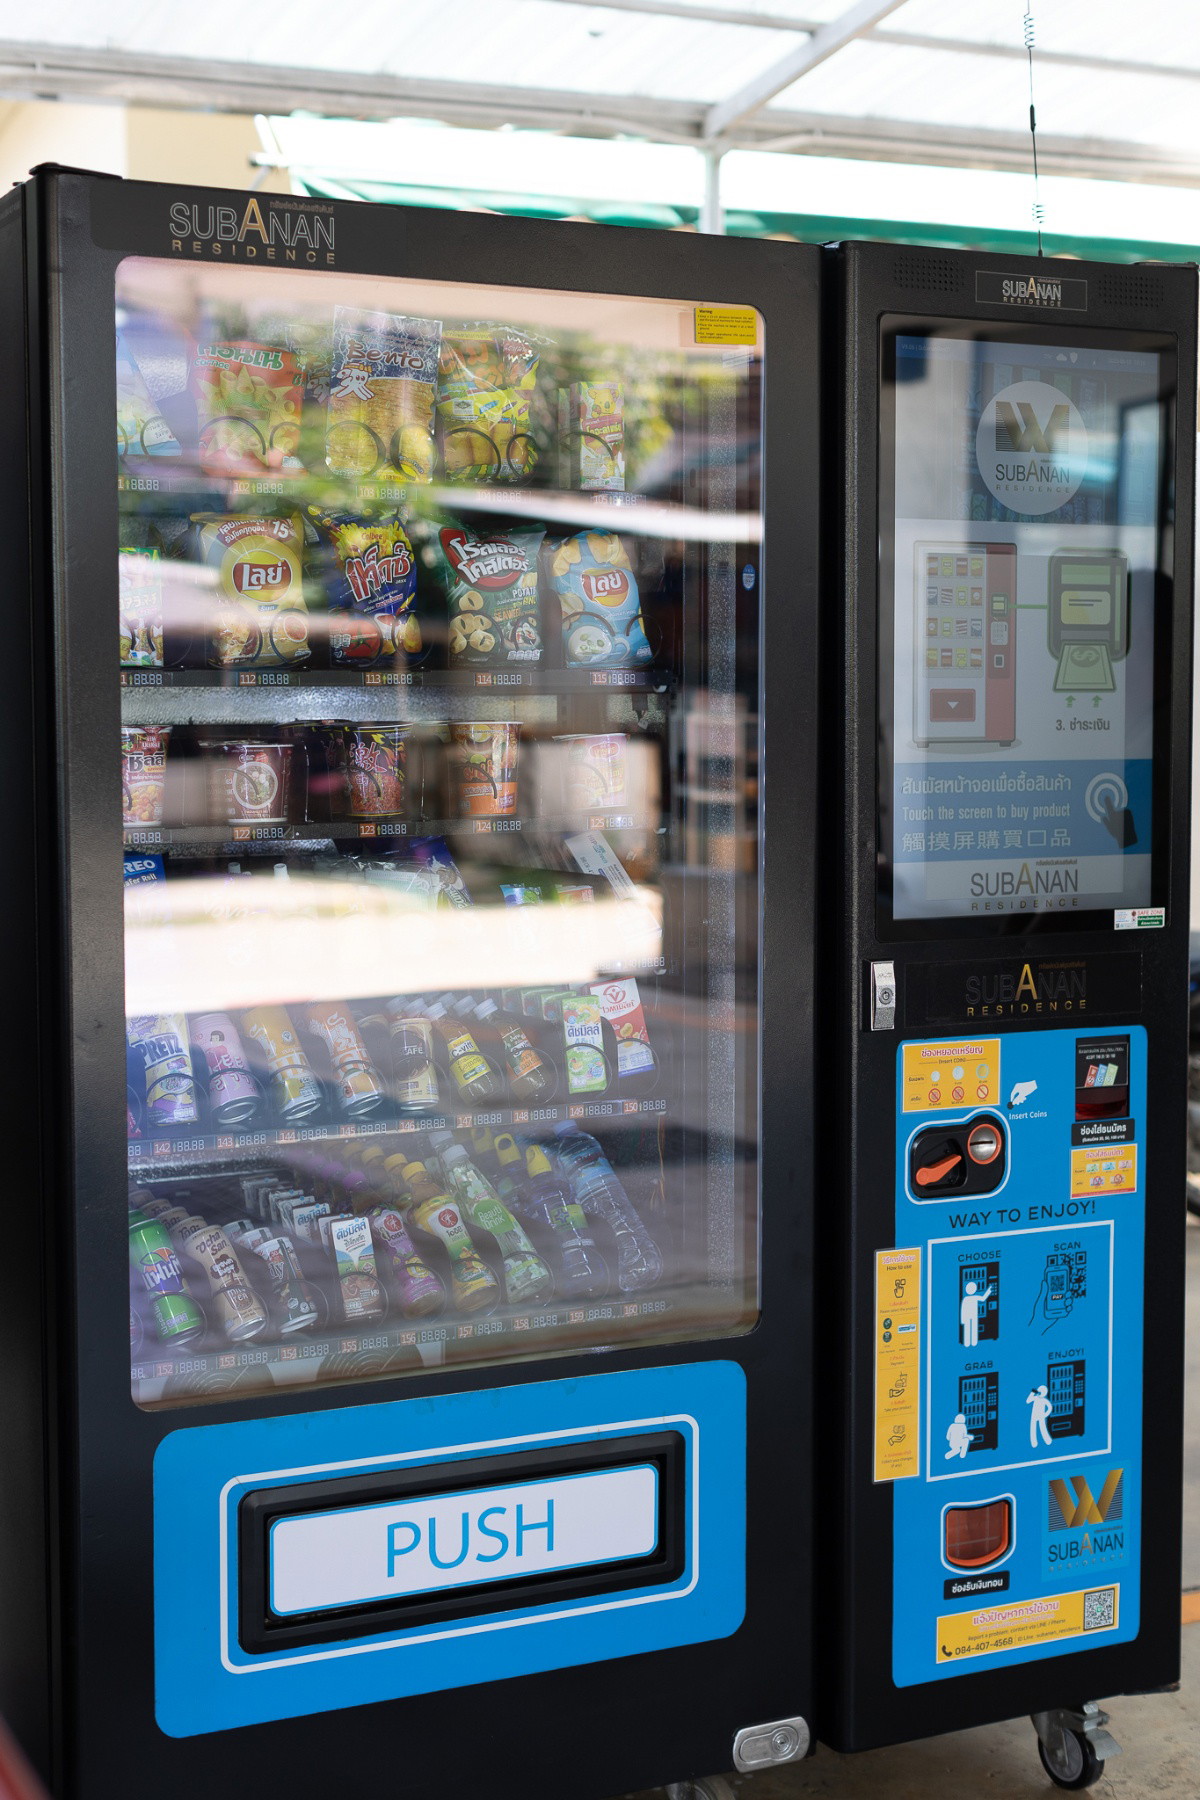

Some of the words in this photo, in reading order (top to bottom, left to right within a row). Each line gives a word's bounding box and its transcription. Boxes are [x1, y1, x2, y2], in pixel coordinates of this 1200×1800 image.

[169, 198, 334, 250] SUBANAN
[172, 239, 336, 264] RESIDENCE
[1002, 276, 1062, 300] SUBANAN
[1003, 296, 1061, 307] RESIDENCE
[347, 339, 424, 370] Bento
[996, 459, 1070, 484] SUBANAN
[272, 520, 289, 538] 15
[133, 674, 162, 684] 88.88
[240, 674, 256, 684] 112
[262, 674, 290, 684] 88.88
[366, 674, 381, 684] 113
[386, 674, 412, 684] 88.88
[478, 674, 492, 684] 114
[497, 674, 522, 684] 88.88
[592, 674, 607, 684] 115
[612, 674, 636, 684] 88.88
[1056, 720, 1066, 731] 3.
[1070, 717, 1110, 731] ชำระเงิน
[902, 770, 1072, 794] สัมผัสหน้าจอเพื่อซื้อสินค้า
[902, 804, 934, 821] Touch
[938, 804, 954, 820] the
[958, 806, 993, 820] screen
[997, 804, 1008, 818] to
[1011, 804, 1028, 821] buy
[1033, 802, 1070, 820] product
[360, 825, 375, 836] 123
[381, 824, 407, 835] 88.88
[476, 821, 492, 832] 124
[496, 820, 522, 832] 88.88
[132, 832, 161, 844] 88.88
[234, 829, 250, 840] 122
[256, 828, 284, 839] 88.88
[970, 862, 1078, 897] SUBANAN
[971, 898, 1078, 912] RESIDENCE
[966, 964, 1087, 1004] SUBANAN
[967, 1000, 1086, 1016] RESIDENCE
[134, 1034, 184, 1064] PRETZ
[921, 1045, 984, 1058] ช่องหยอดเหรียญ
[570, 1107, 584, 1116] 149
[588, 1104, 612, 1116] 88.88
[624, 1102, 638, 1111] 150
[642, 1100, 666, 1111] 88.88
[457, 1116, 472, 1126] 147
[476, 1114, 502, 1124] 88.88
[514, 1112, 528, 1121] 148
[533, 1109, 558, 1120] 88.88
[1008, 1112, 1028, 1120] Insert
[1030, 1110, 1048, 1119] Coins
[340, 1126, 356, 1136] 145
[362, 1124, 387, 1135] 88.88
[400, 1121, 415, 1130] 146
[420, 1118, 446, 1130] 88.88
[217, 1138, 233, 1148] 143
[239, 1134, 267, 1146] 88.88
[280, 1131, 296, 1141] 144
[302, 1128, 328, 1140] 88.88
[154, 1142, 171, 1154] 142
[176, 1140, 204, 1152] 88.88
[949, 1211, 992, 1229] WAY
[996, 1208, 1022, 1223] TO
[1028, 1202, 1096, 1222] ENJOY!
[484, 1216, 506, 1230] Drink
[210, 1240, 227, 1256] San
[1054, 1241, 1082, 1252] SCAN
[957, 1250, 1002, 1262] CHOOSE
[624, 1305, 638, 1314] 160
[642, 1302, 666, 1313] 88.88
[570, 1312, 584, 1322] 159
[588, 1309, 612, 1320] 88.88
[458, 1327, 473, 1336] 157
[477, 1322, 503, 1334] 88.88
[514, 1320, 530, 1329] 158
[532, 1316, 558, 1327] 88.88
[401, 1334, 416, 1344] 156
[421, 1330, 448, 1342] 88.88
[342, 1340, 357, 1351] 155
[362, 1338, 388, 1350] 88.88
[302, 1346, 329, 1358] 88.88
[1048, 1348, 1085, 1360] ENJOY!
[220, 1356, 235, 1366] 153
[242, 1352, 268, 1364] 88.88
[964, 1360, 994, 1371] GRAB
[158, 1364, 174, 1374] 152
[178, 1361, 208, 1372] 88.88
[388, 1498, 554, 1578] PUSH
[1048, 1532, 1124, 1562] SUBANAN
[952, 1578, 1004, 1594] ช่องรับเงินทอน
[954, 1636, 1013, 1656] 084-407-4568
